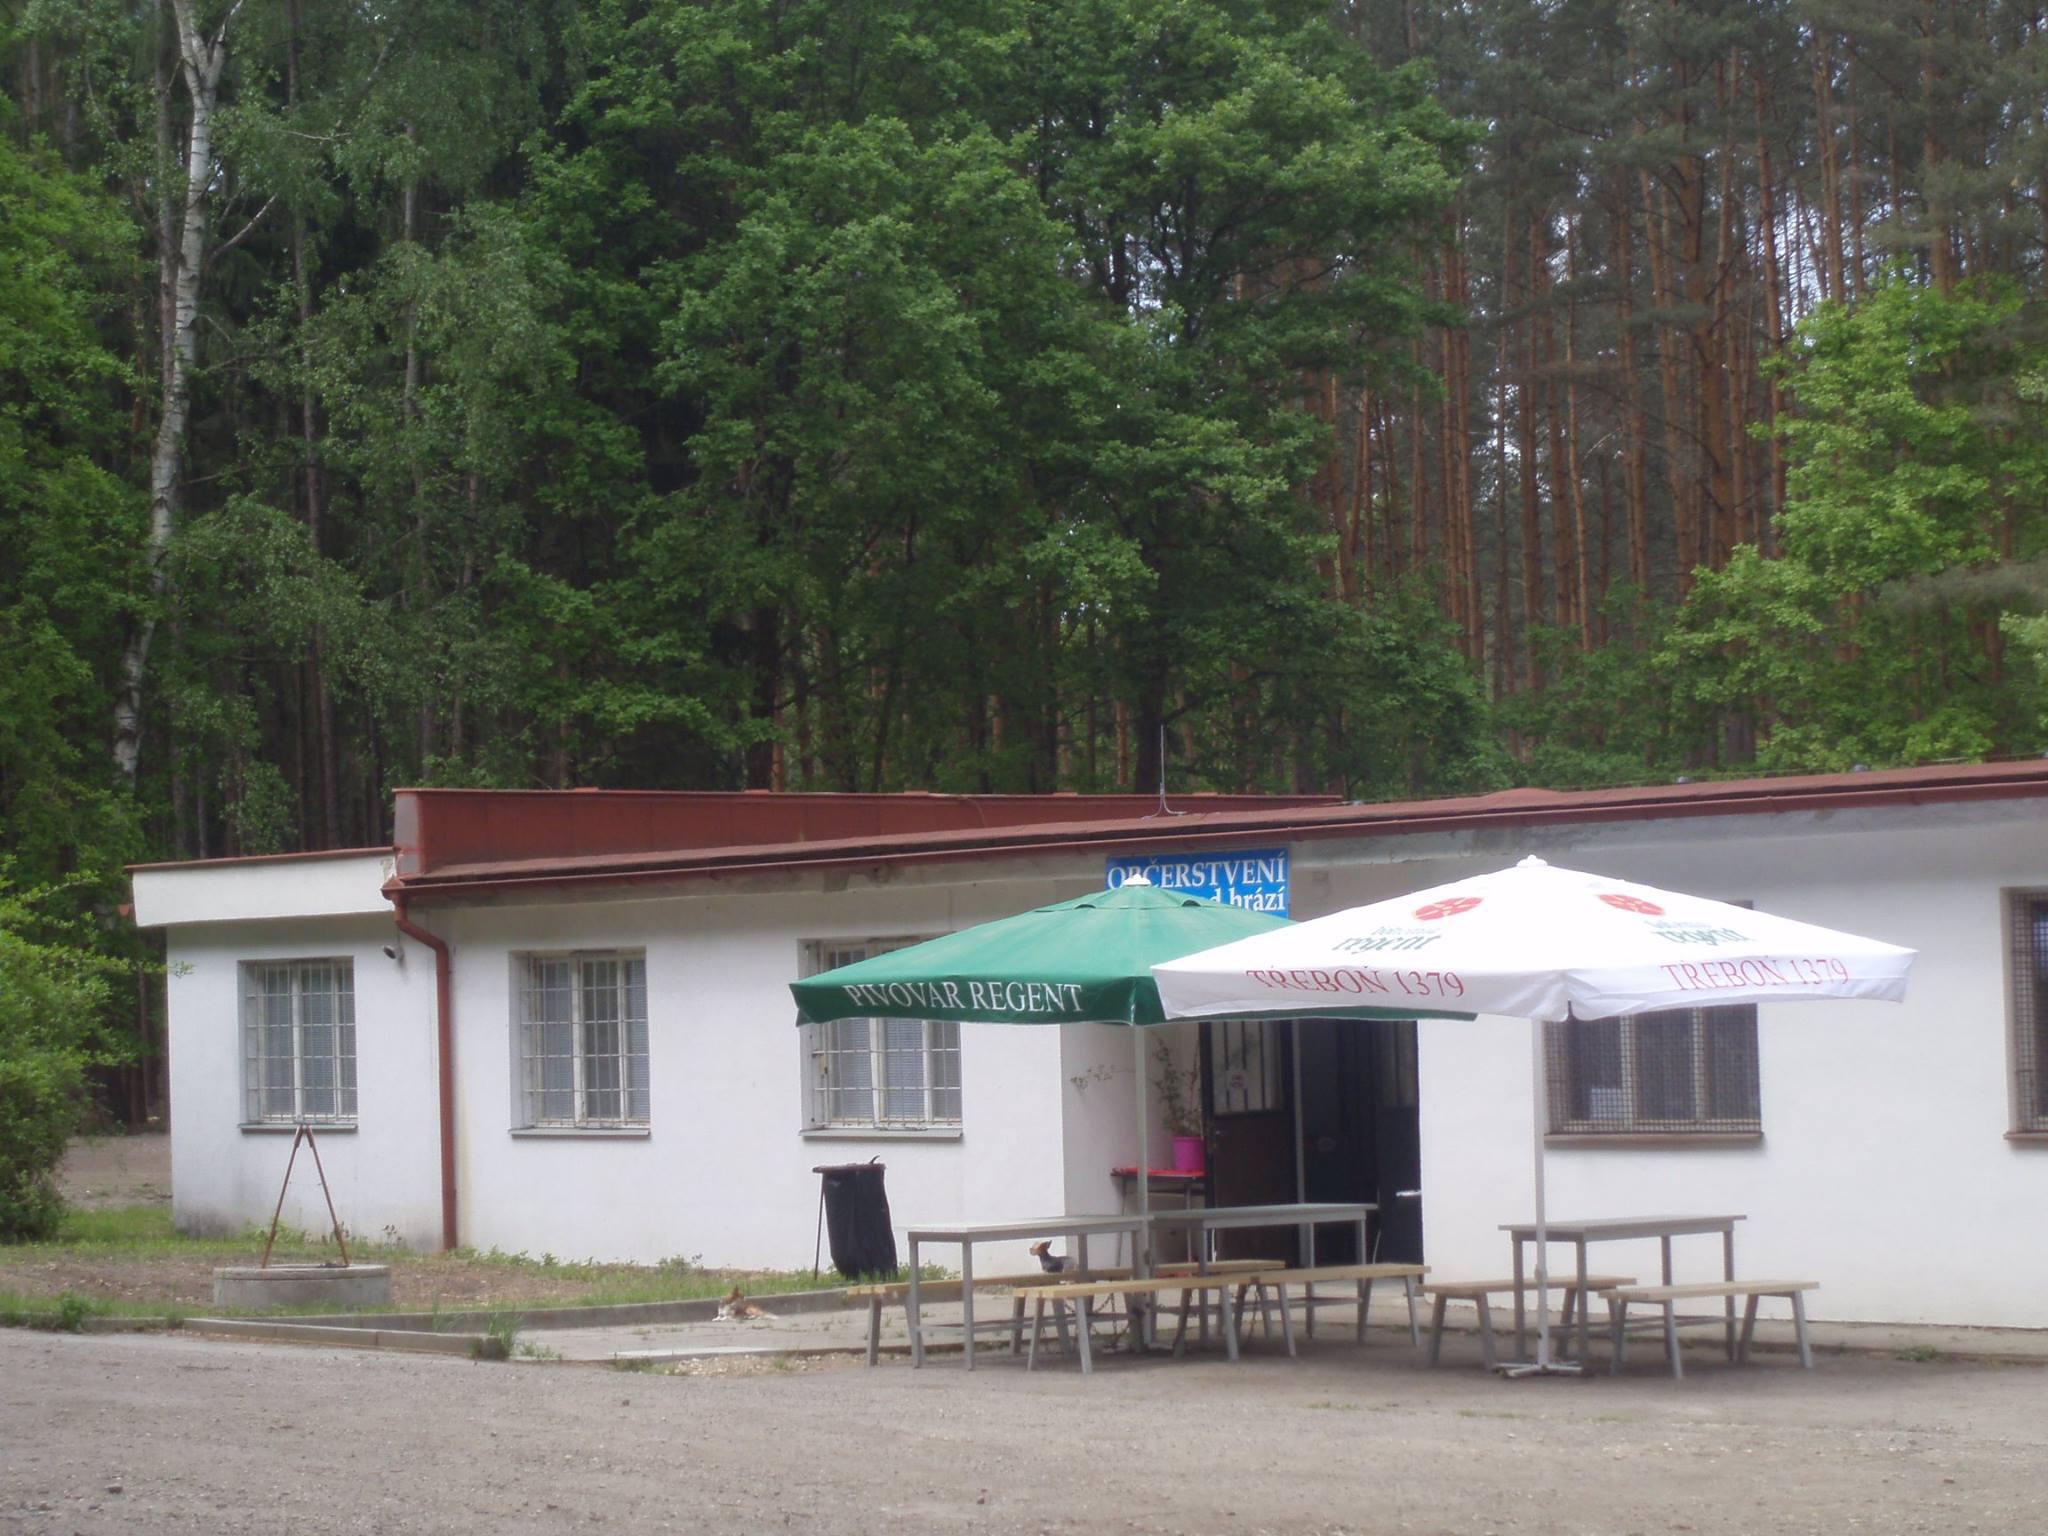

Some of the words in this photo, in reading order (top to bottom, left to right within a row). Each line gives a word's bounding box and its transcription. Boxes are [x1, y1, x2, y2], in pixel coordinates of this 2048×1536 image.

[1229, 886, 1286, 912] hrází
[1392, 971, 1464, 997] 1379
[1790, 958, 1849, 985] 1379
[842, 981, 965, 1008] PIVOVAR
[968, 981, 1083, 1012] REGENT
